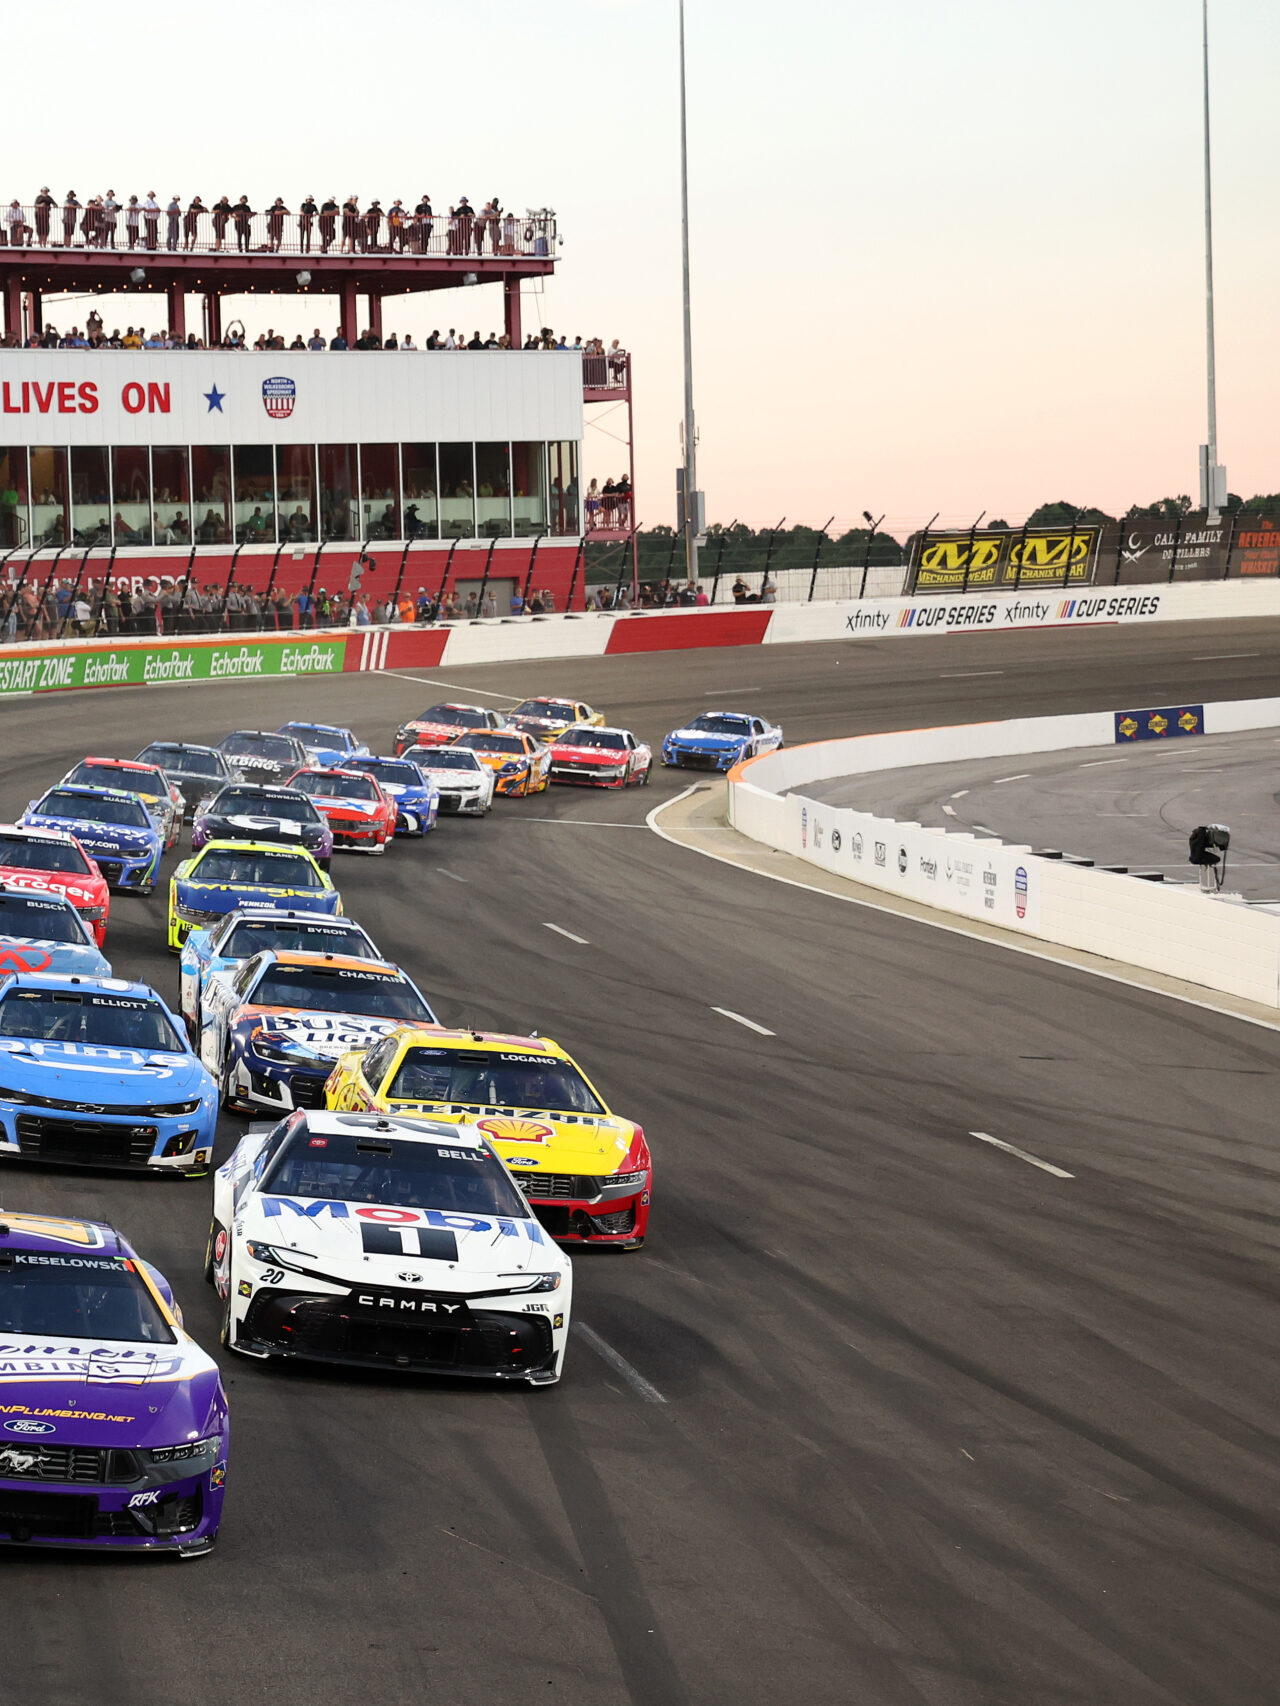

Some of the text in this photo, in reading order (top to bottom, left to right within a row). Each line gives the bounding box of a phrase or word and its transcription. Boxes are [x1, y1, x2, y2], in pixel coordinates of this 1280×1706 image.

[2, 381, 99, 413] LIVES
[121, 382, 171, 414] ON
[1154, 530, 1224, 546] CAL FAMILY
[1162, 547, 1211, 560] DITILLERS
[1006, 564, 1084, 579] MCHANIX WAR
[1004, 597, 1160, 623] xfinity CUP SERIES
[846, 605, 997, 631] xfinity CUP SERIES
[39, 657, 76, 687] ZONE
[83, 653, 130, 683] EchoPark
[143, 651, 193, 680] EchoPark
[209, 647, 262, 677] EchoPark
[280, 645, 335, 673] EchoPark
[78, 838, 119, 850] way.com
[265, 852, 299, 860] BLANEY
[26, 901, 67, 912] BUSCH
[239, 900, 276, 909] PENNZOIL
[182, 923, 193, 931] 12
[307, 927, 347, 937] BYRON
[338, 970, 406, 984] CHASTAIN
[92, 998, 147, 1009] ELLIOTT
[264, 1015, 397, 1036] BUSC
[501, 1054, 557, 1065] LOGANO
[437, 1149, 484, 1162] BELL
[261, 1198, 545, 1246] Mobil
[388, 1226, 421, 1255] 1
[15, 1255, 129, 1273] KESELOWSKI
[260, 1269, 285, 1285] 20
[358, 1295, 460, 1314] CAMRY
[522, 1303, 550, 1312] JGR
[128, 1491, 161, 1508] RFK
